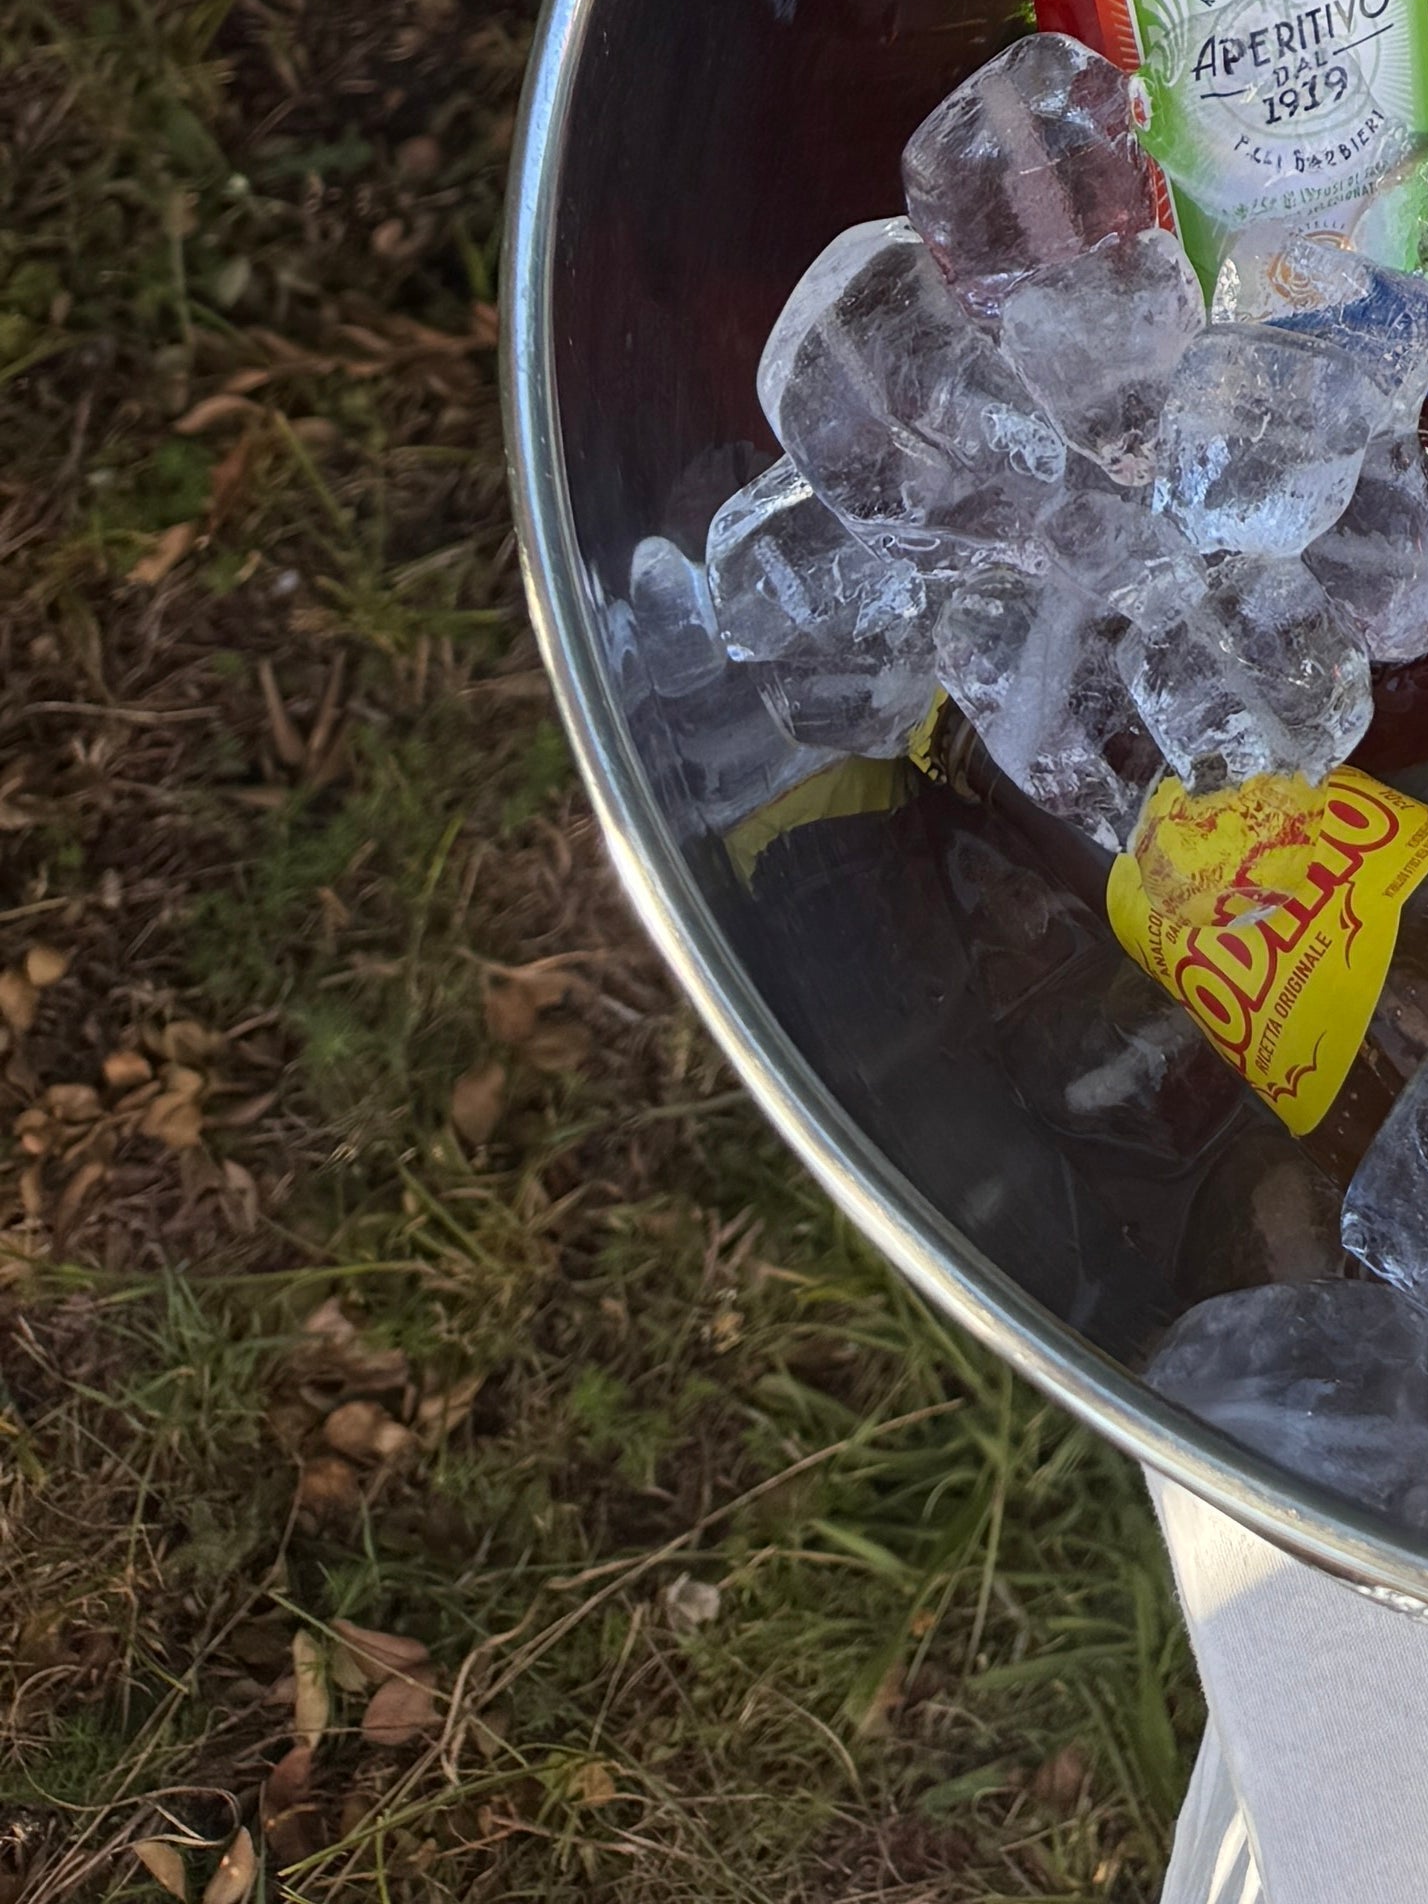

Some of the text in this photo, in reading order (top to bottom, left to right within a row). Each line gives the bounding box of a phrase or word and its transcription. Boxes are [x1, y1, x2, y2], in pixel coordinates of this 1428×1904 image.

[1262, 65, 1349, 126] 1919
[1272, 50, 1329, 88] DAL
[1174, 780, 1401, 1078] ODINO
[1254, 930, 1333, 1077] RICETTA ORIGINALE
